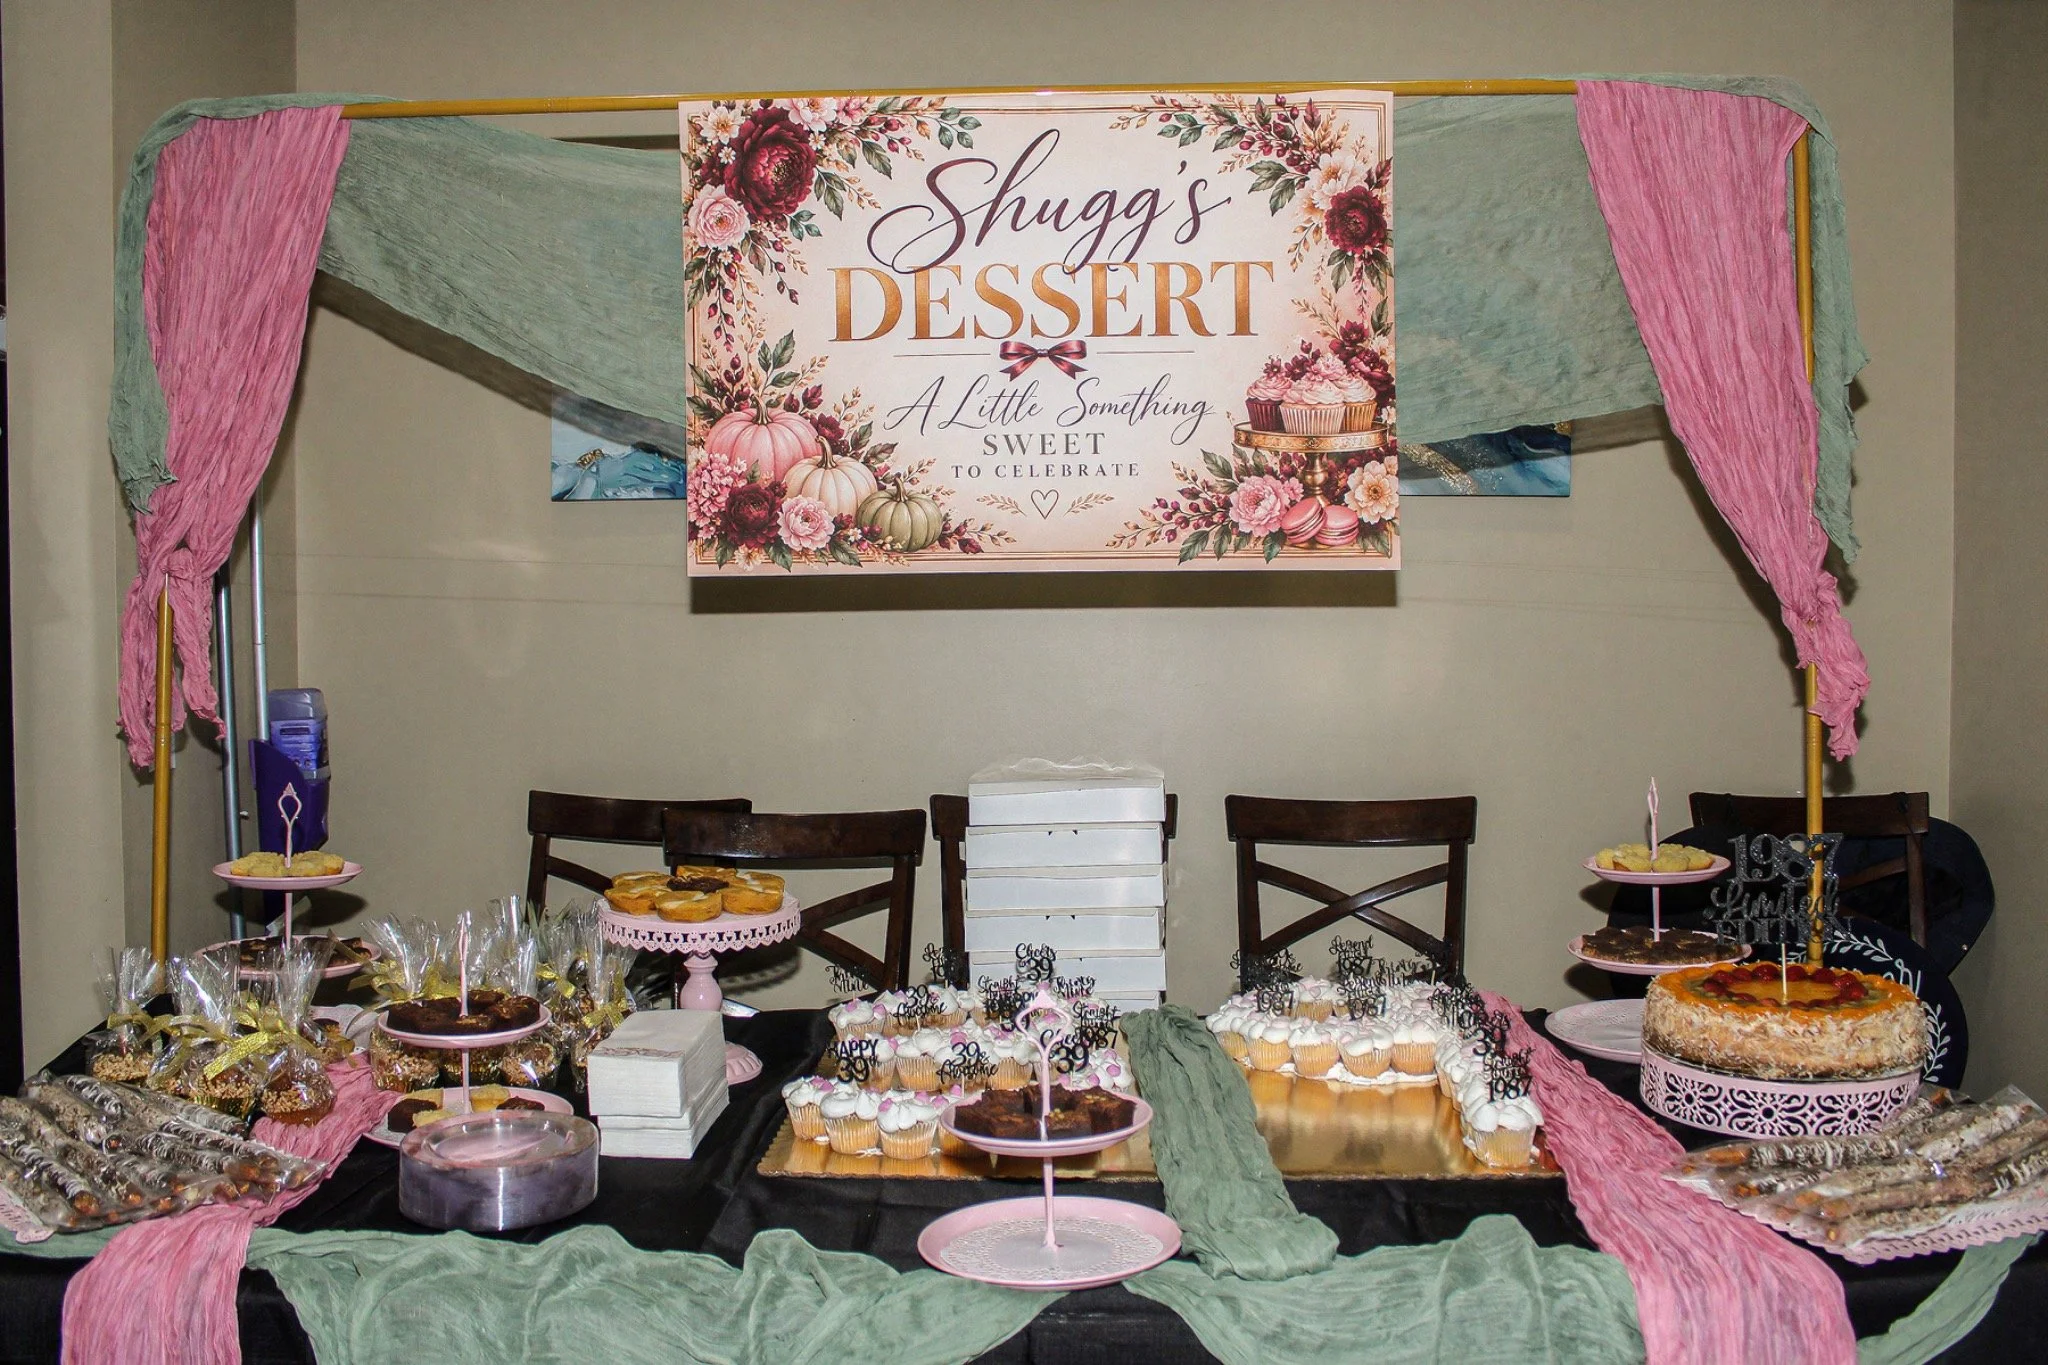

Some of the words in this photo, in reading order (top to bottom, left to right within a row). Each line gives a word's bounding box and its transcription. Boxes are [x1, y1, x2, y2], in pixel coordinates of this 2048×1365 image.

[867, 128, 1232, 275] Shugg's
[827, 261, 1275, 342] DESSERT
[883, 375, 946, 436] A
[937, 373, 1044, 430] Little
[1056, 372, 1216, 446] Something
[982, 432, 1106, 456] SWEET
[951, 465, 982, 479] TO
[994, 462, 1140, 478] CELEBRATE
[1727, 832, 1844, 882] 1987
[1703, 879, 1840, 920] Limited
[1026, 957, 1054, 981] 39
[906, 984, 930, 1010] 39
[825, 1039, 879, 1059] HAPPY
[951, 1041, 981, 1067] 39
[1056, 1043, 1089, 1074] 39
[1486, 1075, 1533, 1104] 1987
